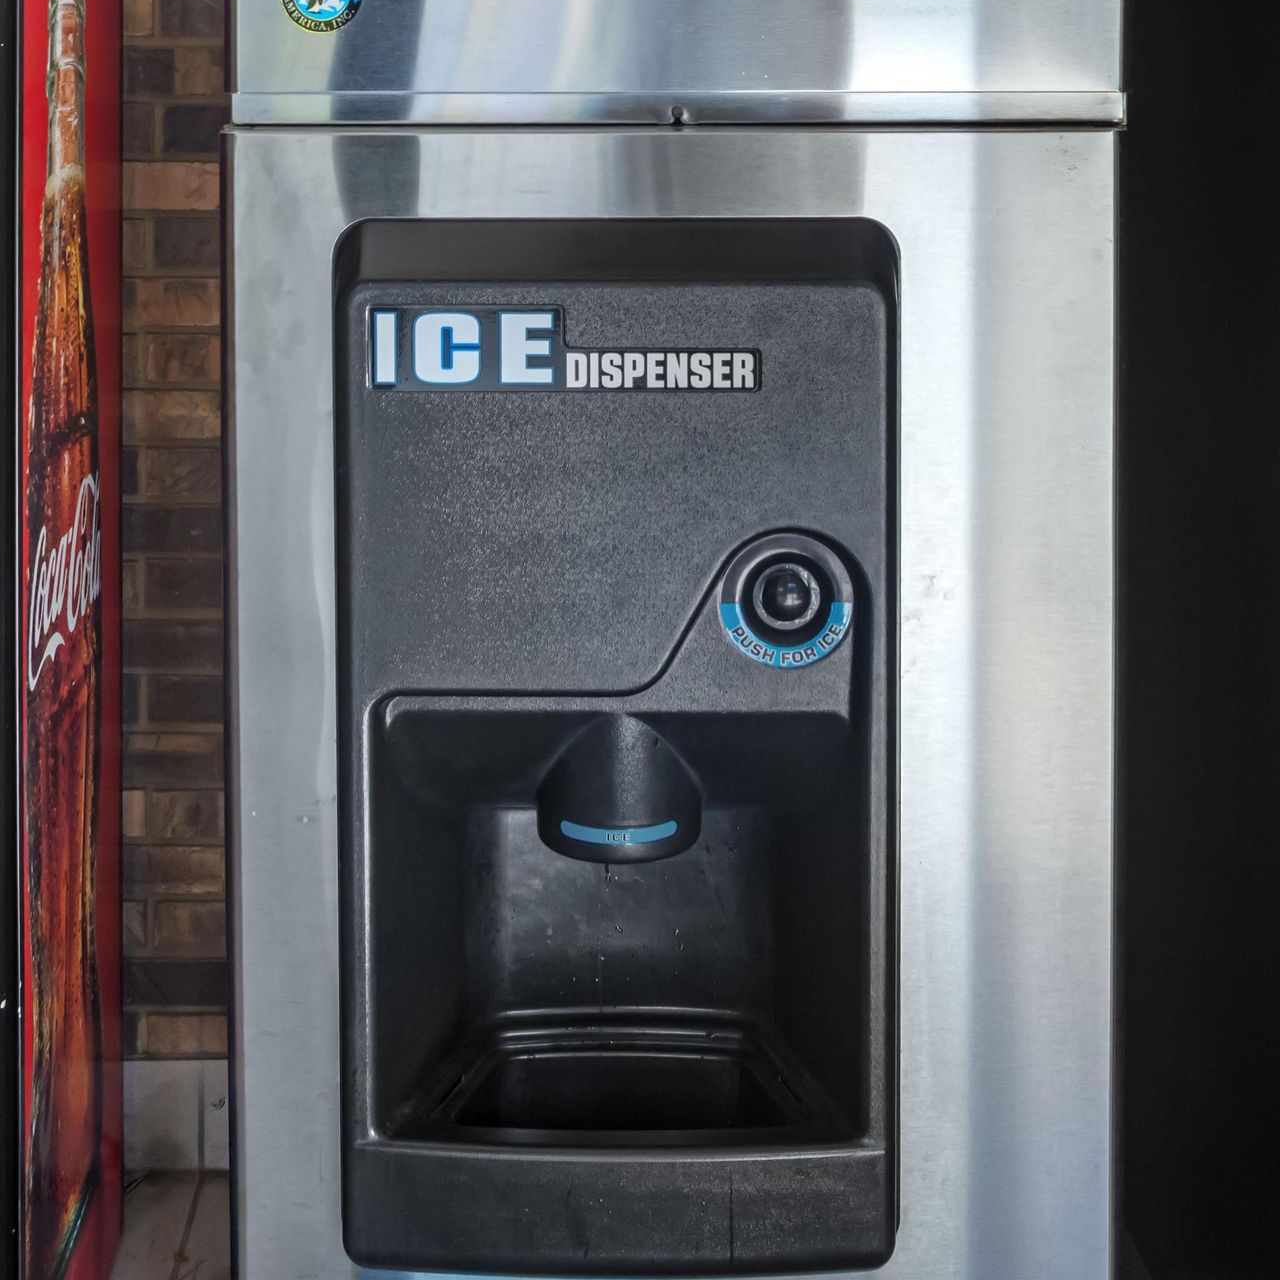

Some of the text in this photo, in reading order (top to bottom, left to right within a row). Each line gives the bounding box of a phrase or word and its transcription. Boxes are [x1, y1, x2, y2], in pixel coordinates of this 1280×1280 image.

[331, 9, 356, 28] INC.
[373, 311, 755, 389] ICE DISPENSER
[28, 470, 101, 692] Coca-Cola
[731, 624, 842, 664] PUSH FOR ICE
[605, 833, 631, 842] ICE
